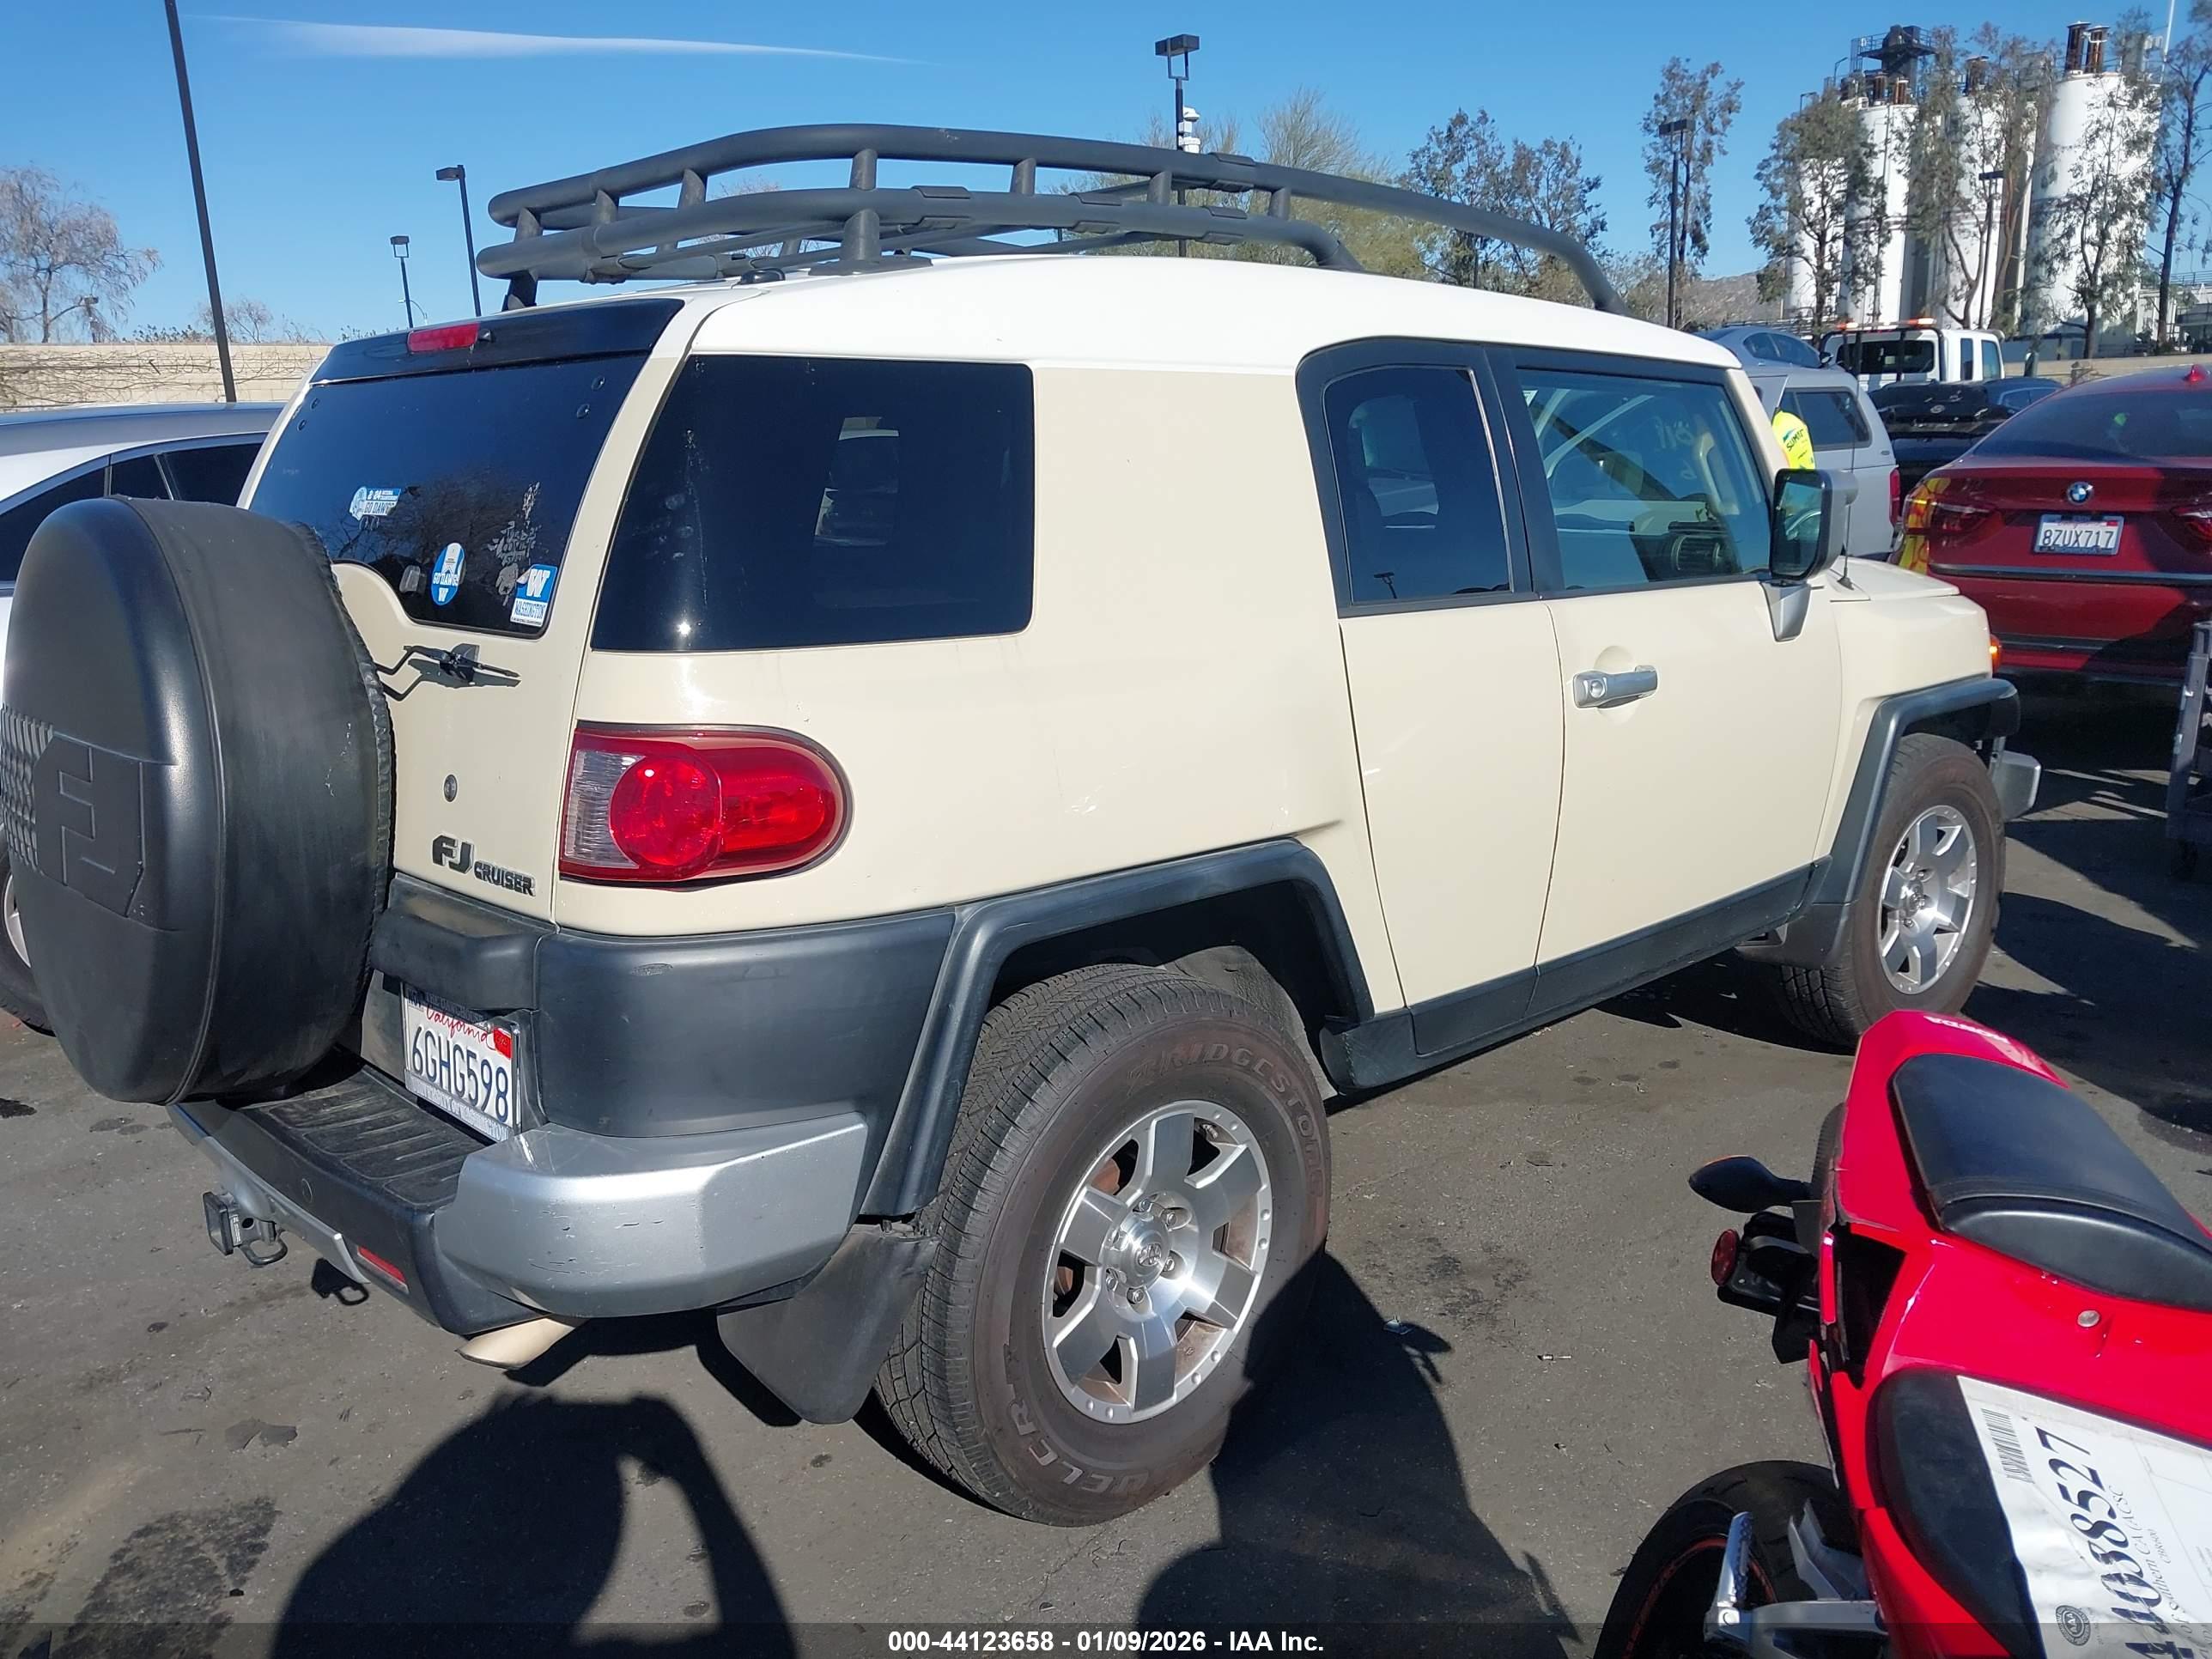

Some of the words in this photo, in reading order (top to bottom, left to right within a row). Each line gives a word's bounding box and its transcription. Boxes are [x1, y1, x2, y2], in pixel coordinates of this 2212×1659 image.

[2042, 529, 2115, 549] 8ZUX717
[526, 568, 550, 599] W
[432, 834, 475, 875] FJ
[473, 860, 537, 897] CRUISER
[425, 1007, 491, 1045] California
[412, 1025, 508, 1123] 6GHG598
